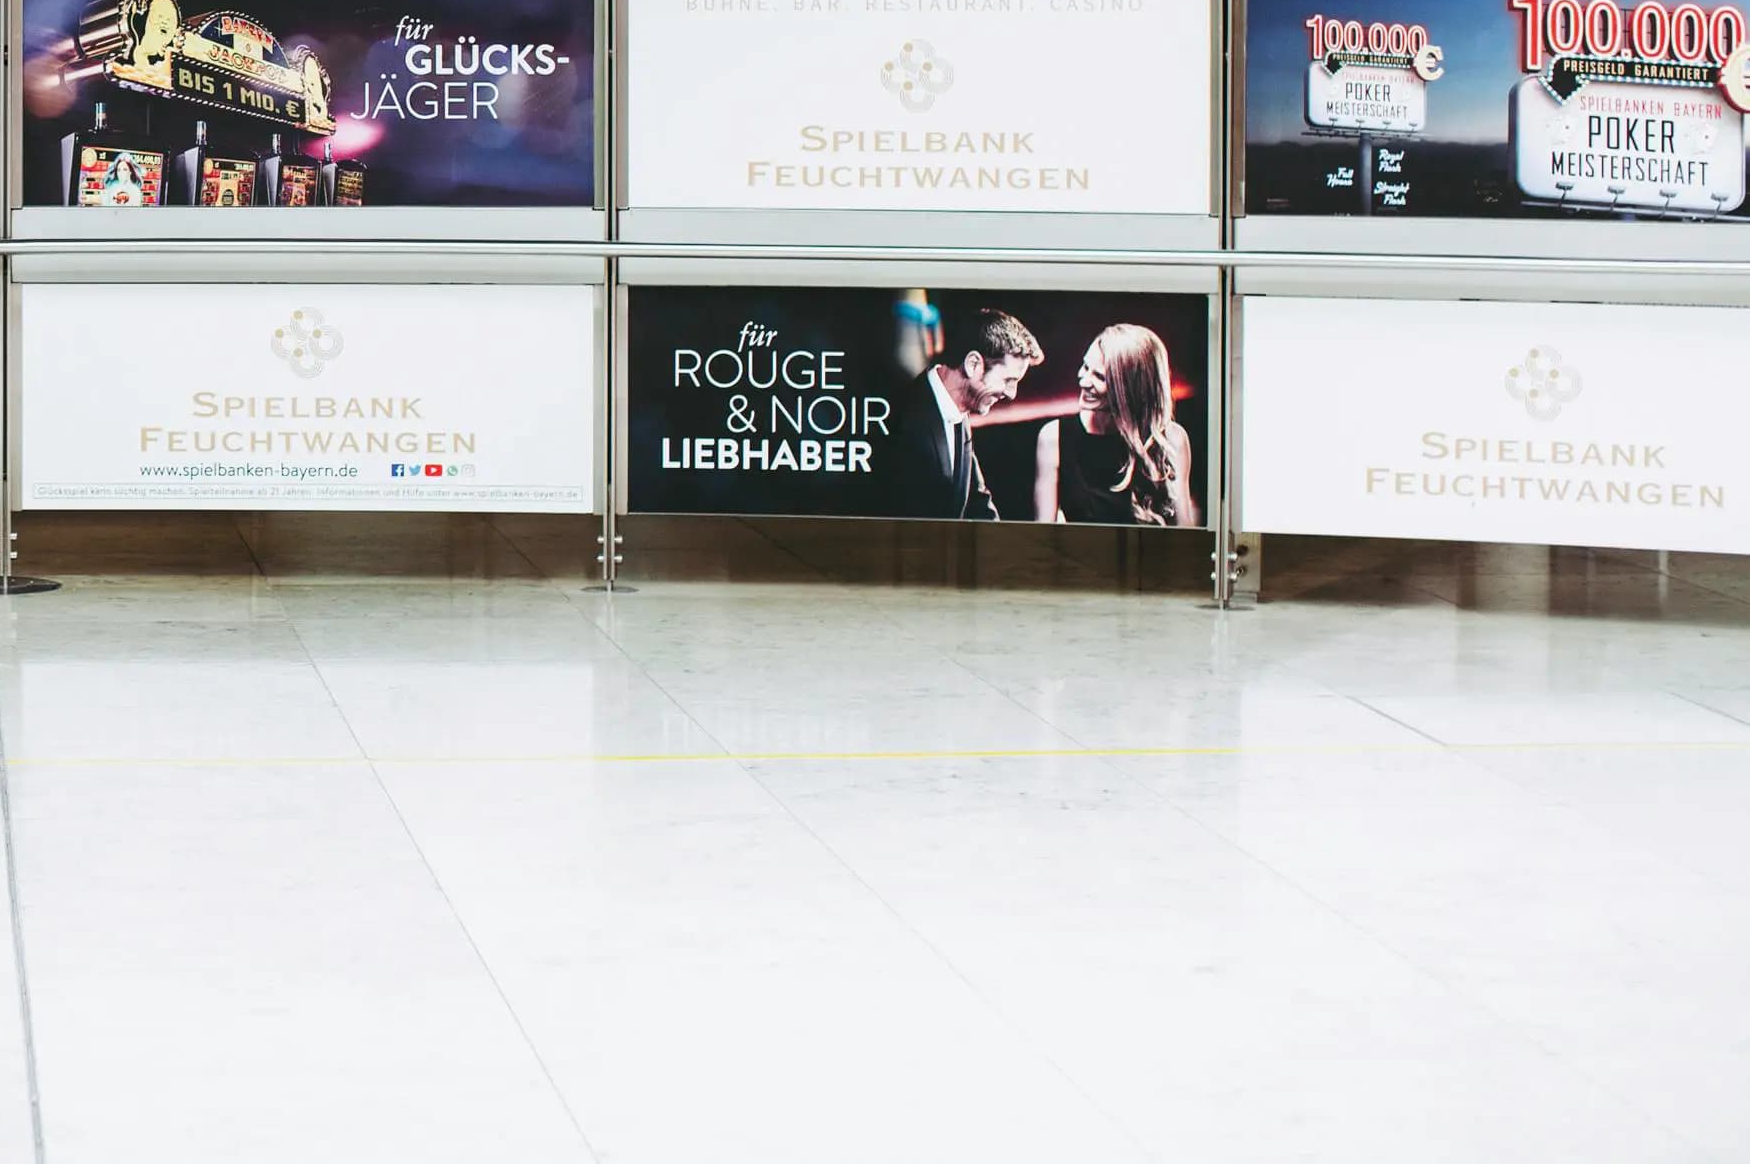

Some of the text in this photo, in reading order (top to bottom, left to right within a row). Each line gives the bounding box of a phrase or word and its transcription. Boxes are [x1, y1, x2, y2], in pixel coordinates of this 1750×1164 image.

[394, 16, 433, 47] für
[1305, 14, 1444, 81] 100.000 €
[406, 36, 570, 75] GLÜCKS-
[1563, 60, 1710, 81] PREISGELD GARANTIERT
[178, 68, 215, 94] BIS
[223, 82, 232, 100] 1
[286, 100, 300, 118] €
[351, 73, 498, 120] JÄGER
[1345, 83, 1391, 102] POKER
[1580, 95, 1722, 120] SPIELBANKEN BAYERN
[1326, 101, 1407, 119] MEISTERSCHAFT
[800, 125, 1036, 154] SPIELBANK
[1588, 115, 1675, 154] POKER
[747, 161, 1090, 190] FEUCHTWANGEN
[1551, 151, 1710, 186] MEISTERSCHAFT
[738, 321, 777, 353] für
[674, 349, 845, 389] ROUGE
[192, 391, 423, 420] SPIELBANK
[726, 394, 891, 435] & NOIR
[140, 427, 477, 455] FEUCHTWANGEN
[662, 438, 872, 473] LIEBHABER
[1421, 431, 1666, 468] SPIELBANK
[140, 461, 358, 480] www.spielbanken-bayern.de
[1365, 467, 1725, 509] FEUCHTWANGEN
